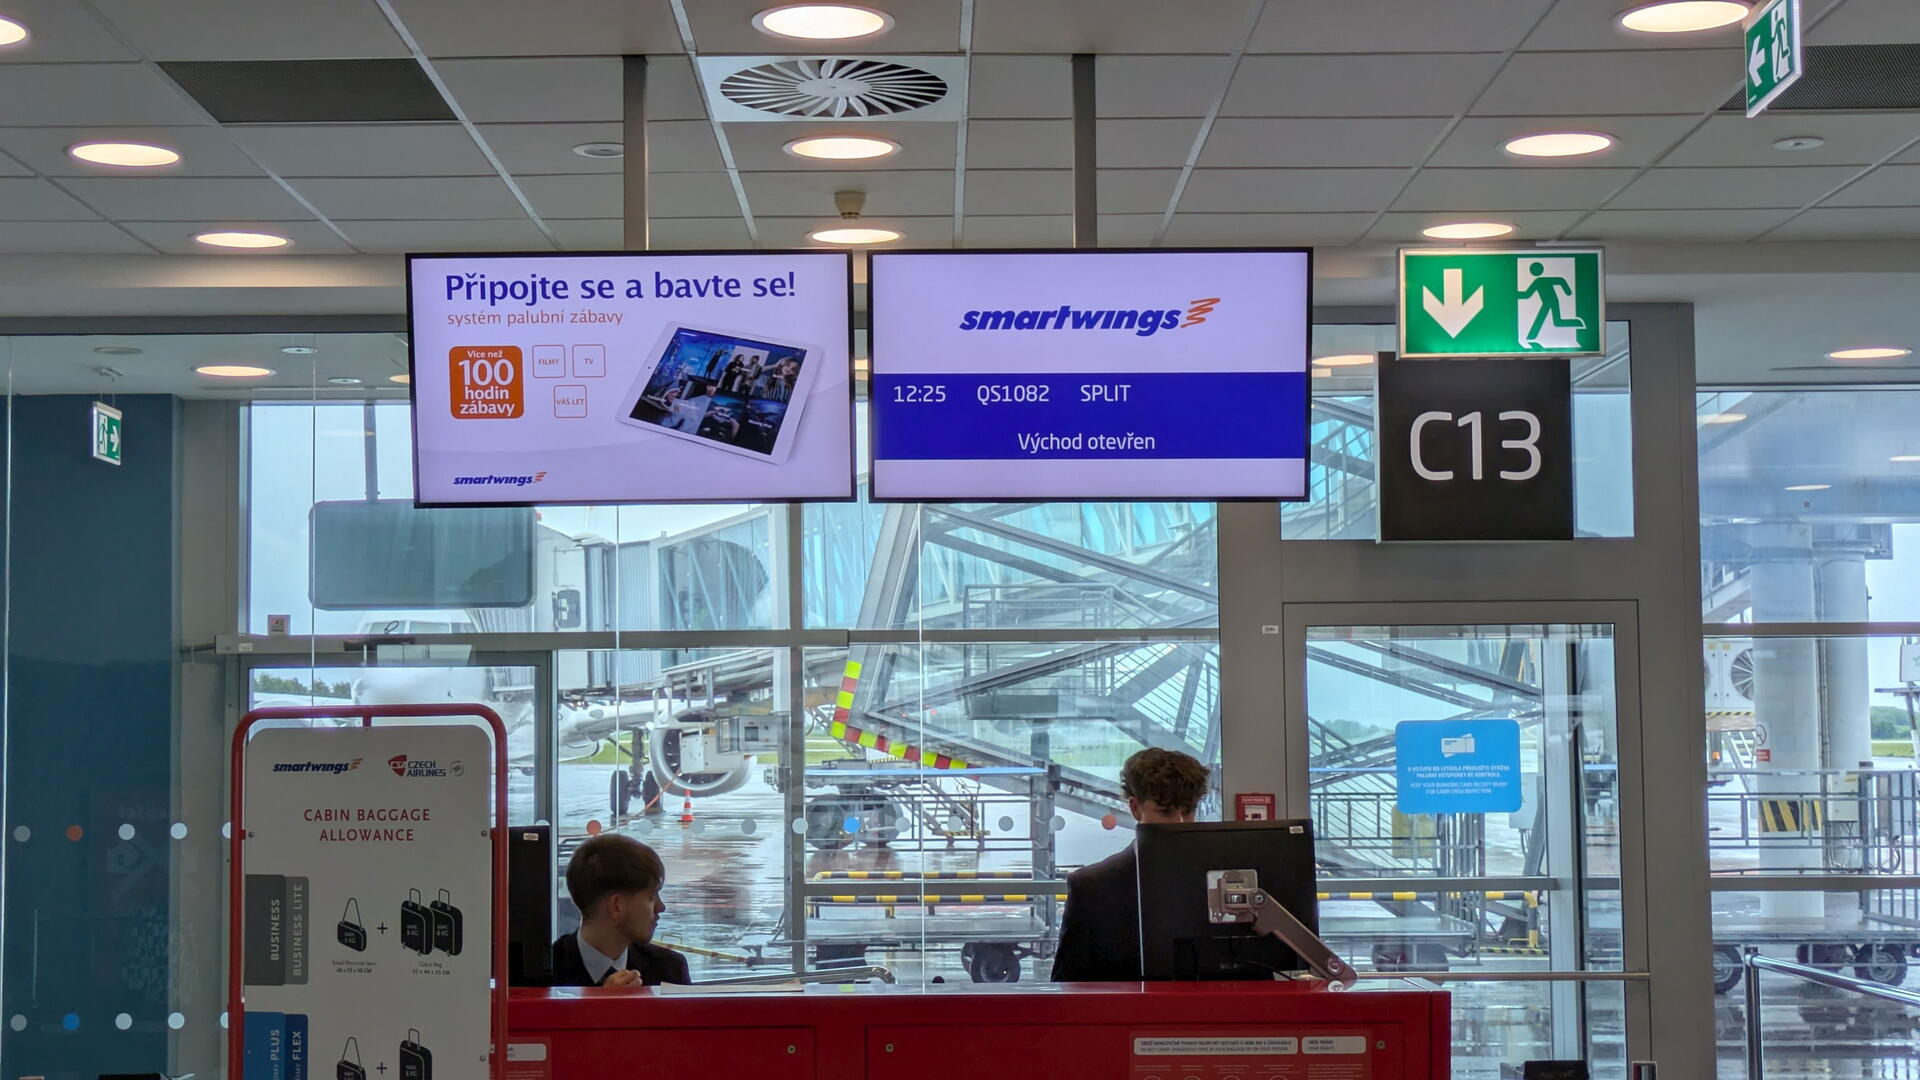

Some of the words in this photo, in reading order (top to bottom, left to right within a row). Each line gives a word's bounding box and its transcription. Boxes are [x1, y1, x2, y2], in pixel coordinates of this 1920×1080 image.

[446, 273, 568, 306] Připojte
[580, 279, 615, 299] se
[626, 278, 644, 298] a
[654, 272, 741, 298] bavte
[752, 272, 796, 298] se!
[447, 310, 501, 327] systém
[507, 310, 564, 326] palubní
[570, 310, 624, 326] zábavy
[959, 305, 1181, 337] smartwings
[468, 350, 485, 358] Více
[488, 350, 504, 358] než
[458, 360, 515, 386] 100
[464, 386, 509, 400] hodin
[893, 386, 946, 402] 12:25
[977, 385, 1050, 404] QS1082
[1080, 384, 1130, 402] SPLIT
[460, 400, 515, 416] zábavy
[1018, 433, 1082, 454] Východ
[1088, 433, 1156, 450] otevřen
[1410, 410, 1542, 482] C13
[453, 472, 534, 487] smartwings
[272, 761, 350, 774] smartwings
[406, 769, 446, 777] AIRLINES
[408, 761, 436, 769] CZECH
[304, 809, 350, 822] CABIN
[358, 808, 430, 822] BAGGAGE
[320, 828, 414, 841] ALLOWANCE
[294, 884, 303, 910] LITE
[270, 899, 280, 961] BUSINESS
[293, 914, 302, 976] BUSINESS
[270, 1029, 280, 1061] PLUS
[292, 1031, 302, 1060] FLEX
